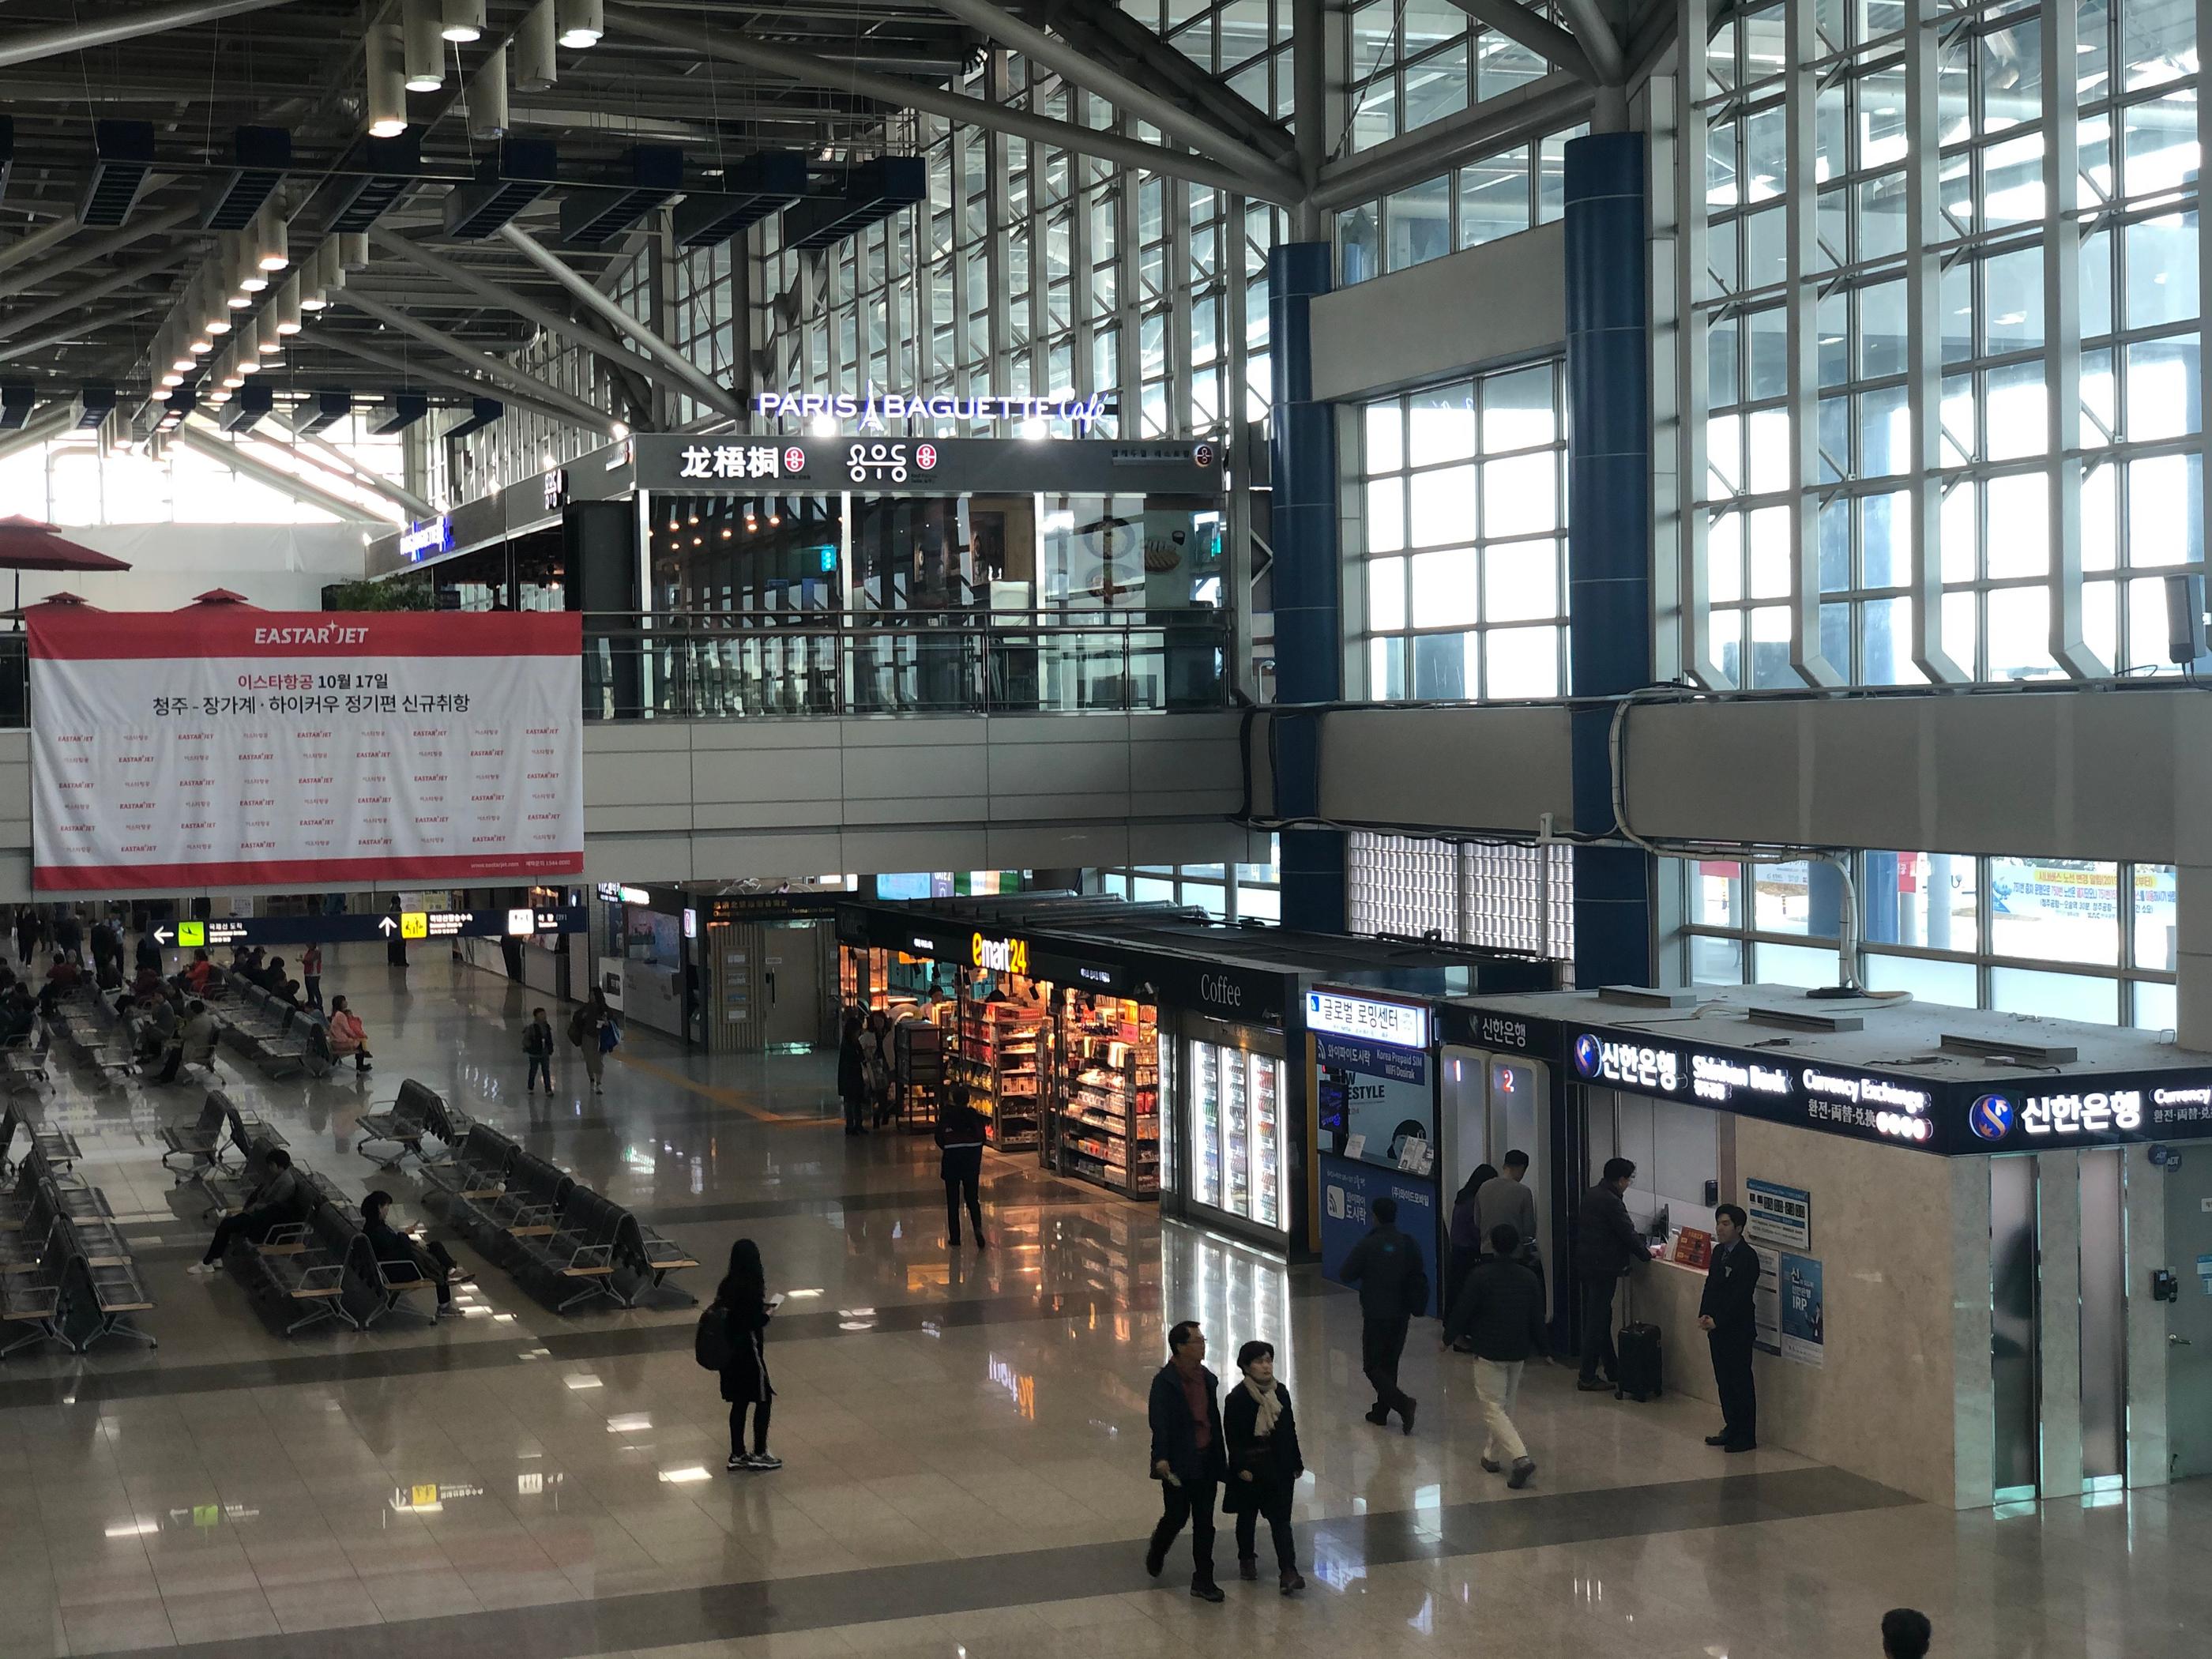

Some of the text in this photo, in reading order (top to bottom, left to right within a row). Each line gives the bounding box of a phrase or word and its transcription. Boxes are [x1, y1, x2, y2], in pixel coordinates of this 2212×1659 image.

[758, 393, 857, 417] PARIS
[884, 394, 1051, 419] BAGUETTE
[680, 445, 779, 479] 龙梧桐
[254, 627, 368, 644] EASTAR JET
[239, 673, 388, 690] 이스타항공 10월 17일
[152, 696, 188, 716] 청주
[203, 697, 255, 714] 장가계
[269, 695, 339, 714] 하이커우
[345, 695, 396, 713] 정기편
[402, 694, 470, 713] 신규취항
[972, 932, 1027, 974] emart24
[1201, 973, 1241, 1007] Coffee
[1324, 998, 1352, 1024] 글로벌
[1358, 1004, 1398, 1031] 로밍센터
[1482, 1018, 1526, 1048] 신한은행
[1327, 1044, 1423, 1066] 와이파이도시락 Korea Prepaid SIM
[1385, 1064, 1415, 1080] WiFi Dosirak
[1503, 1069, 1514, 1093] 2
[1601, 1042, 1677, 1091] 신한은행
[1802, 1068, 1860, 1103] Currency
[1860, 1078, 1928, 1114] Exchange
[1348, 1085, 1385, 1100] ESTYLE
[2021, 1088, 2212, 1134] 신한은행 Currency
[2154, 1107, 2212, 1123] 환전·両替·兑
[1345, 1205, 1366, 1225] 도시락
[1793, 1296, 1808, 1311] IRP
